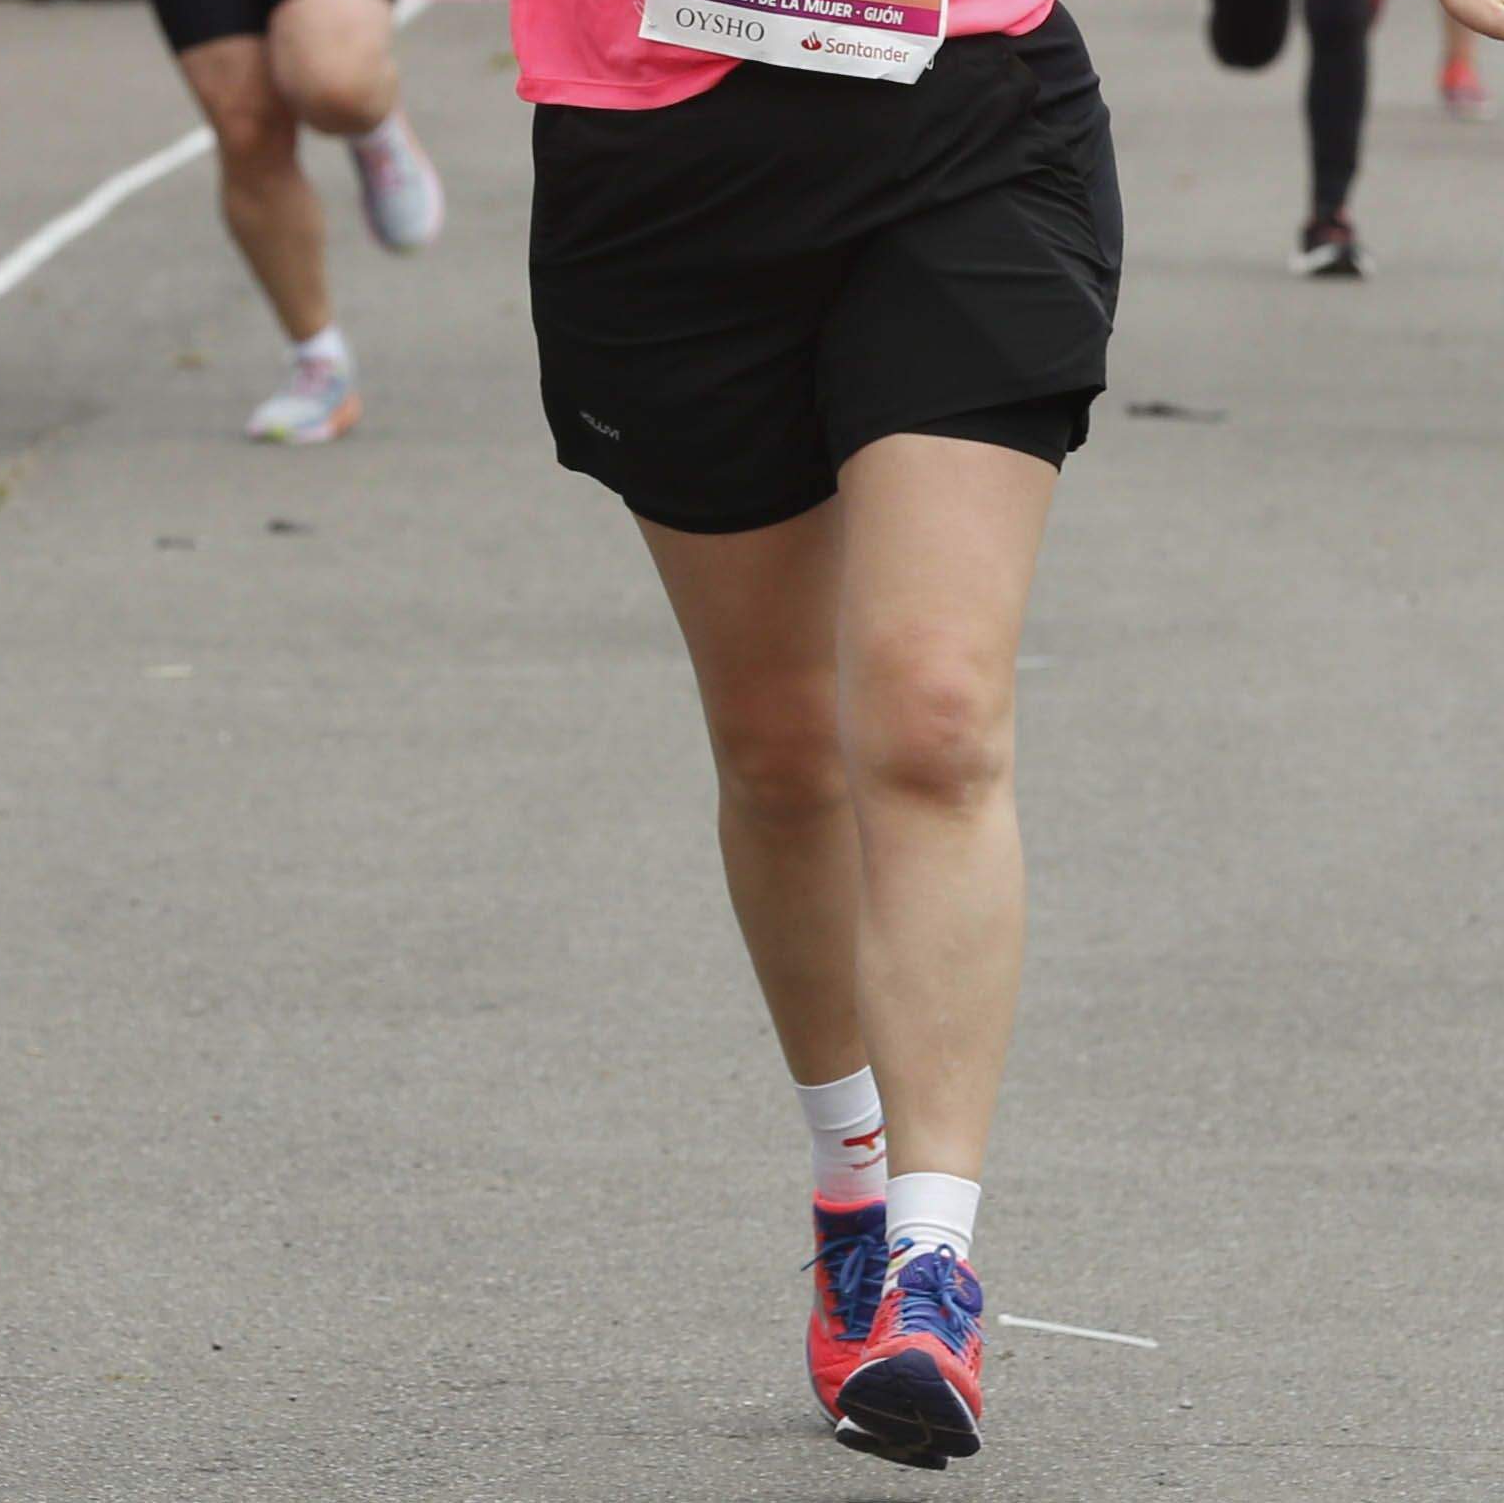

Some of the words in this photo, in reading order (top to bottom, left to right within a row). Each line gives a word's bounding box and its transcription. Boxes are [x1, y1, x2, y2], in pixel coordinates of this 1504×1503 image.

[675, 7, 766, 43] OYSHO
[863, 3, 905, 26] GIJÓN
[824, 37, 909, 64] Santander
